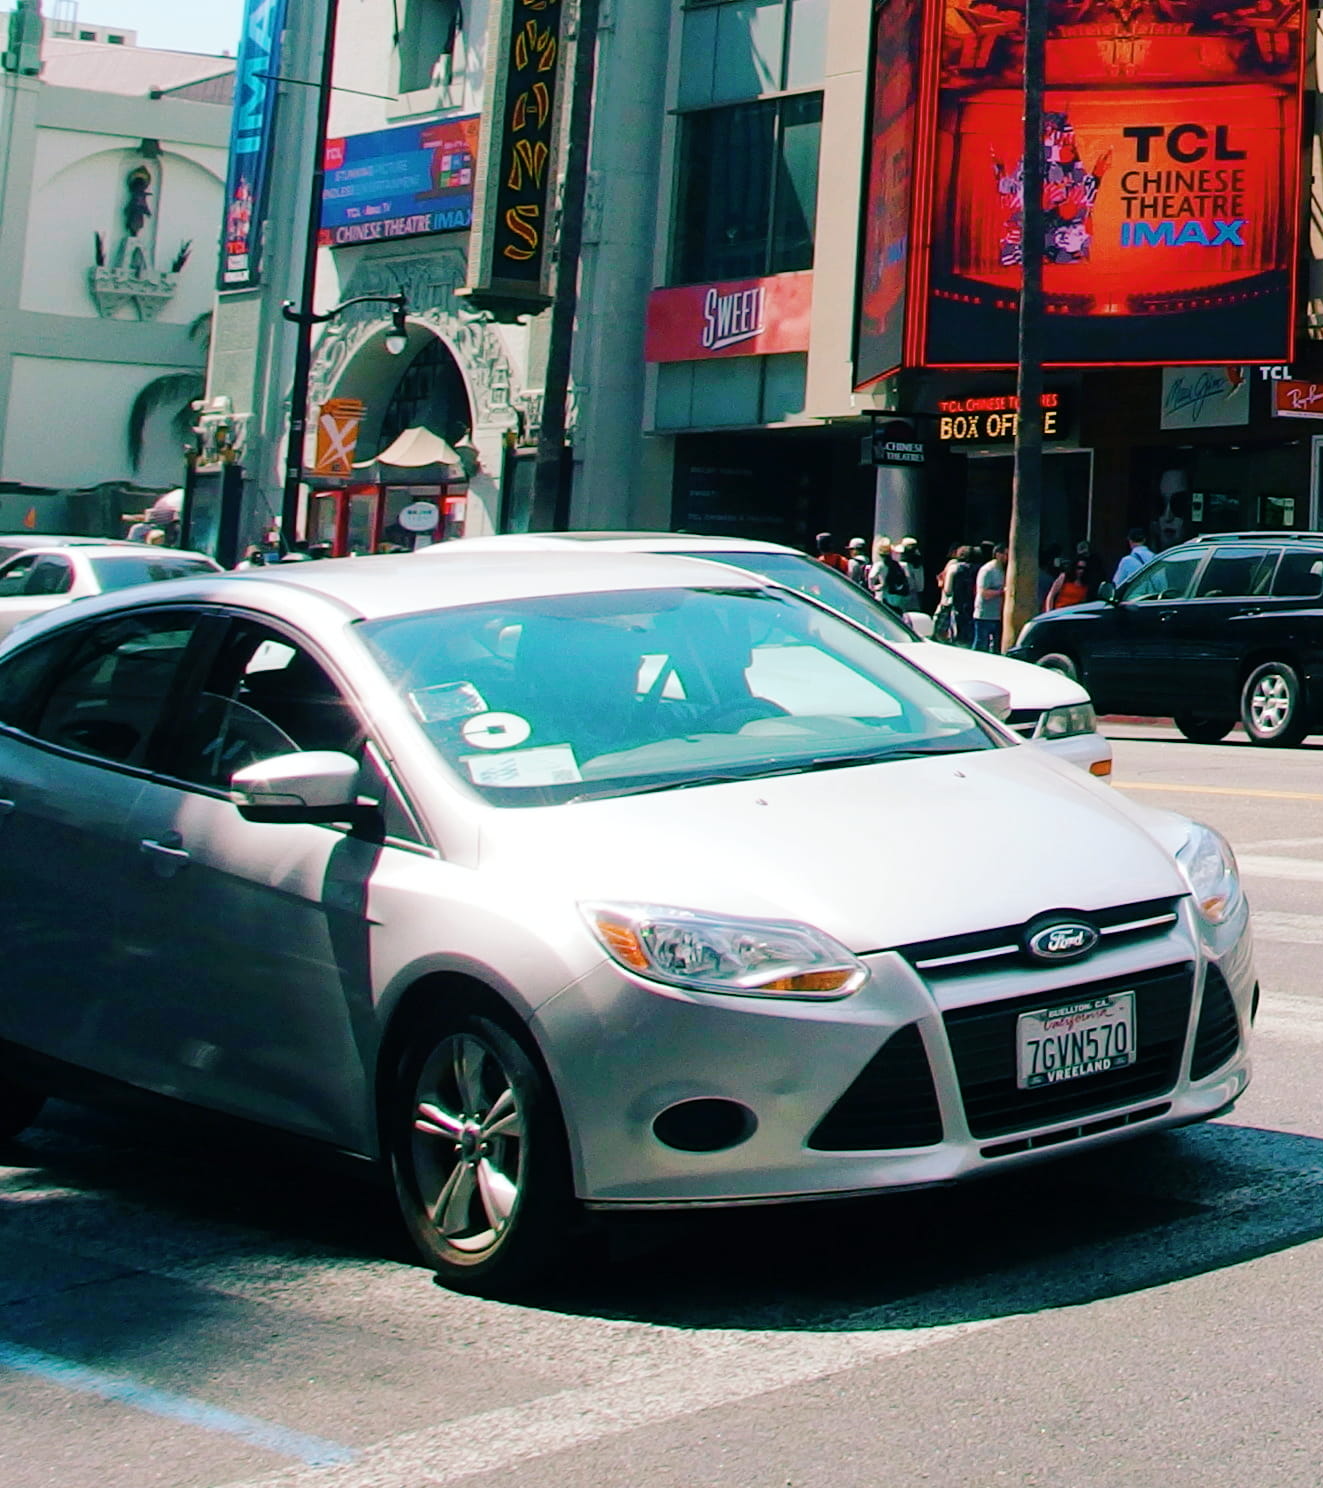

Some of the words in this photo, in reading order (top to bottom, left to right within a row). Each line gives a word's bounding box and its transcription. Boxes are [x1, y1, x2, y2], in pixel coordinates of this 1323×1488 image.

[1122, 123, 1248, 164] TCL
[1120, 169, 1246, 194] CHINESE
[1120, 194, 1245, 218] THEATRE
[335, 220, 384, 244] CHINESE
[384, 213, 433, 237] THEATRE
[1120, 219, 1247, 247] IMAX
[702, 286, 767, 349] SWEET!
[1259, 366, 1293, 381] TCL
[939, 400, 963, 413] TCL
[965, 397, 1007, 411] CHINESE
[939, 415, 979, 440] BOX
[1047, 928, 1085, 951] Ford
[1026, 1021, 1129, 1073] 7GVN570
[1047, 1058, 1112, 1083] VREELAND
